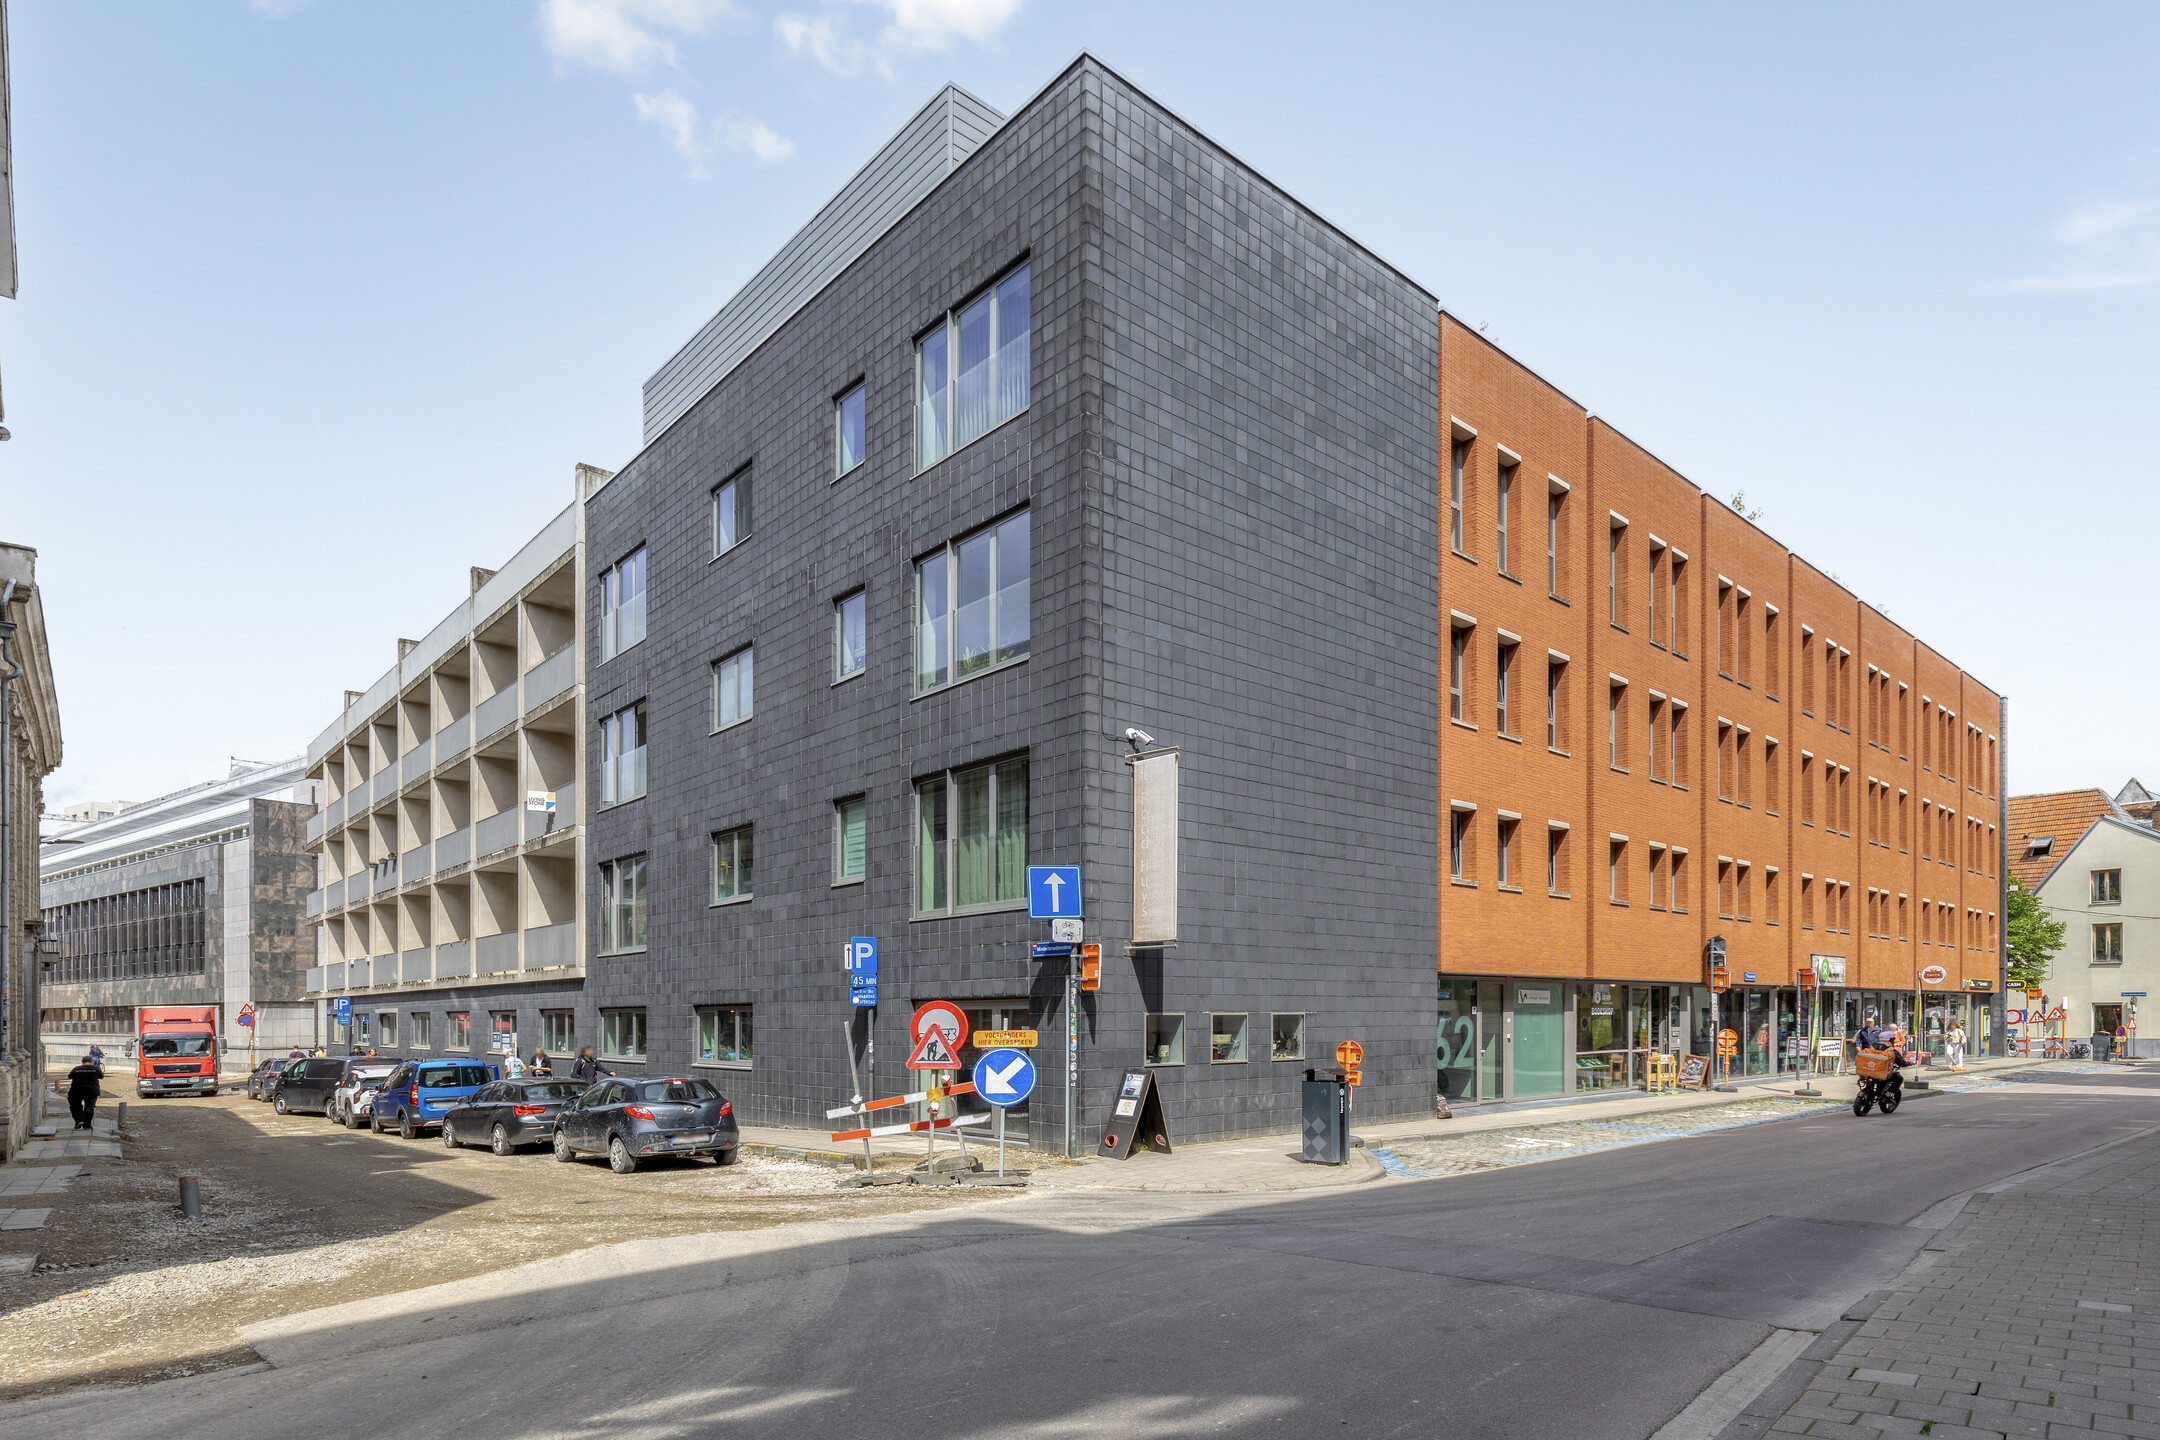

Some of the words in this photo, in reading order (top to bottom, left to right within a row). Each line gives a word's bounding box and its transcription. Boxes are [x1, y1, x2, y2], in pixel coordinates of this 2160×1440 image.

[1140, 860, 1149, 916] Huys
[855, 942, 874, 969] P
[853, 976, 864, 985] 45
[866, 977, 876, 985] MIN
[339, 1000, 348, 1010] P
[1437, 1015, 1475, 1070] 62
